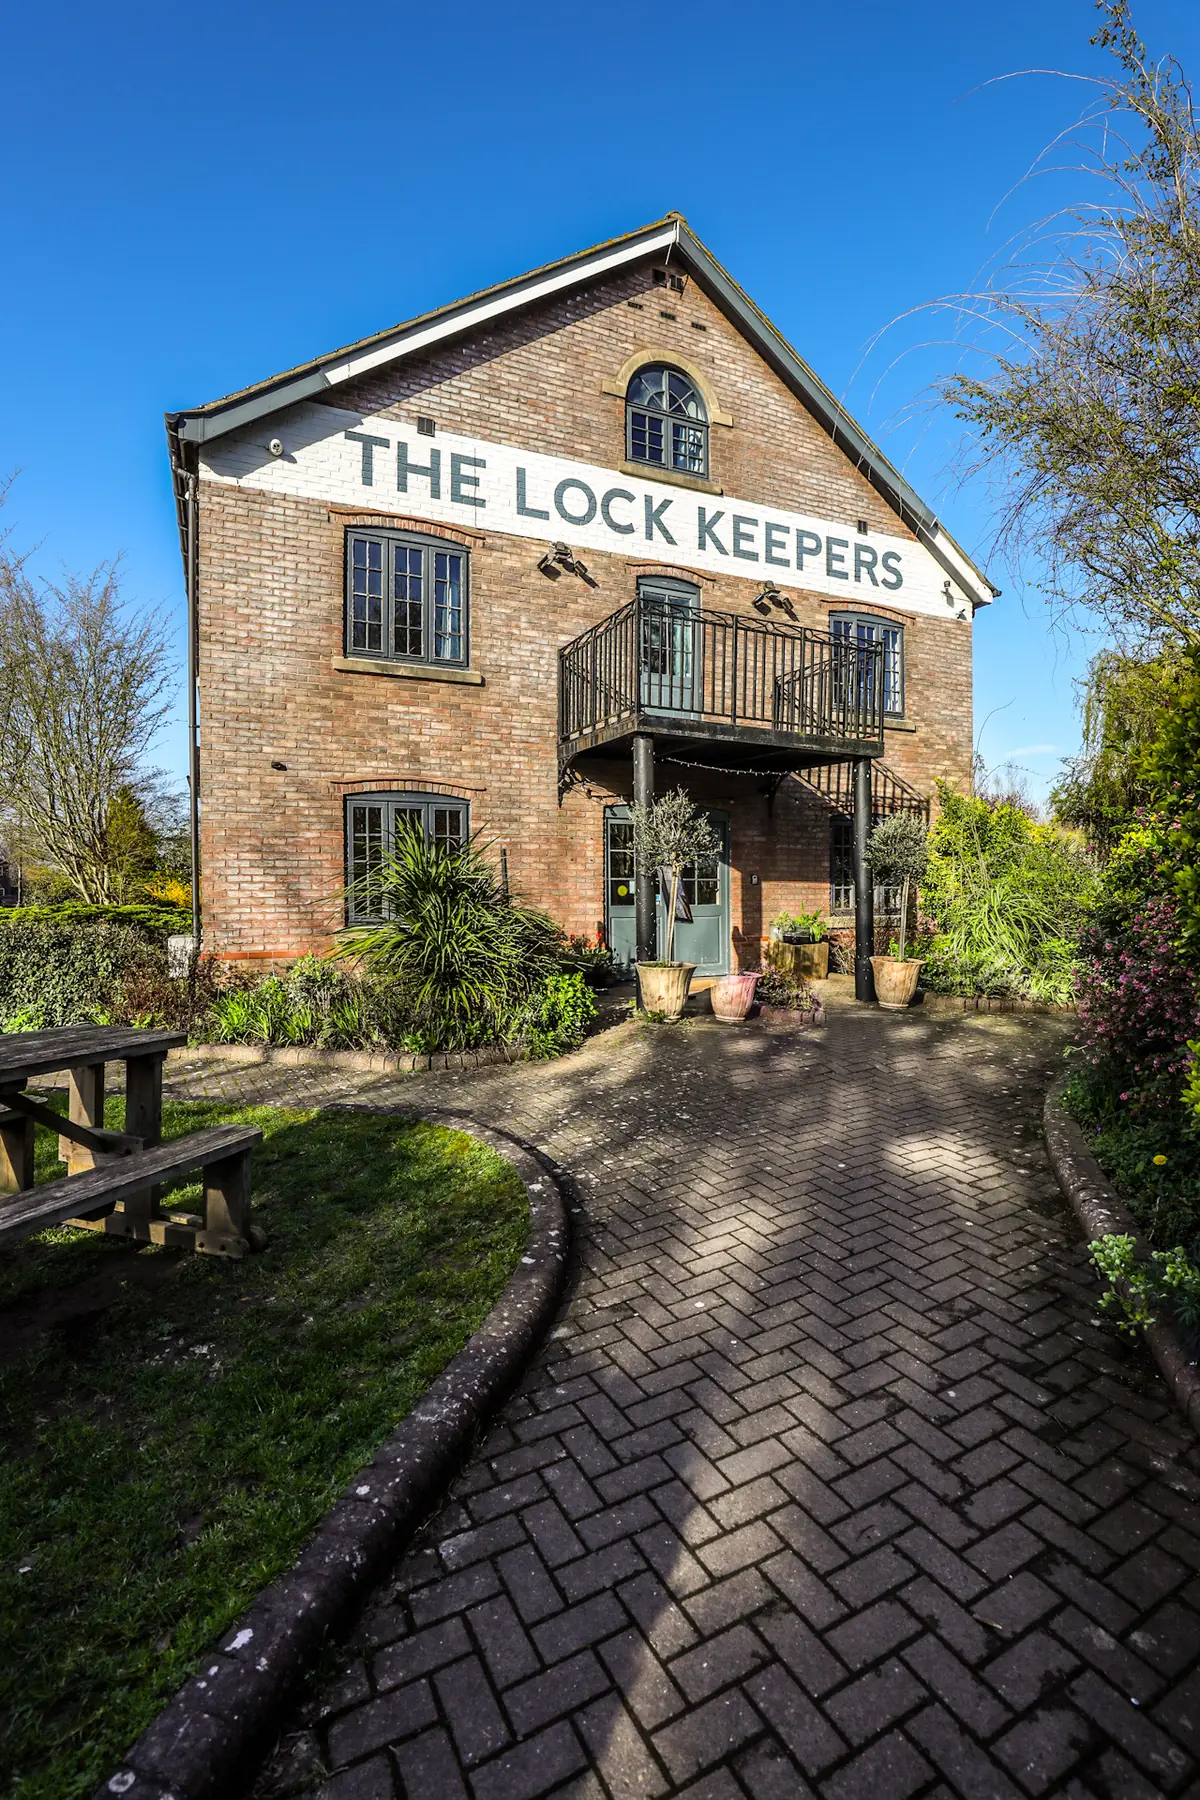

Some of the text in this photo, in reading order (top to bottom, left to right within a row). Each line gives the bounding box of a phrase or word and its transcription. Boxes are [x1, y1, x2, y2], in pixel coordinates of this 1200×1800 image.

[344, 430, 904, 591] THE LOCK KEEPERS
